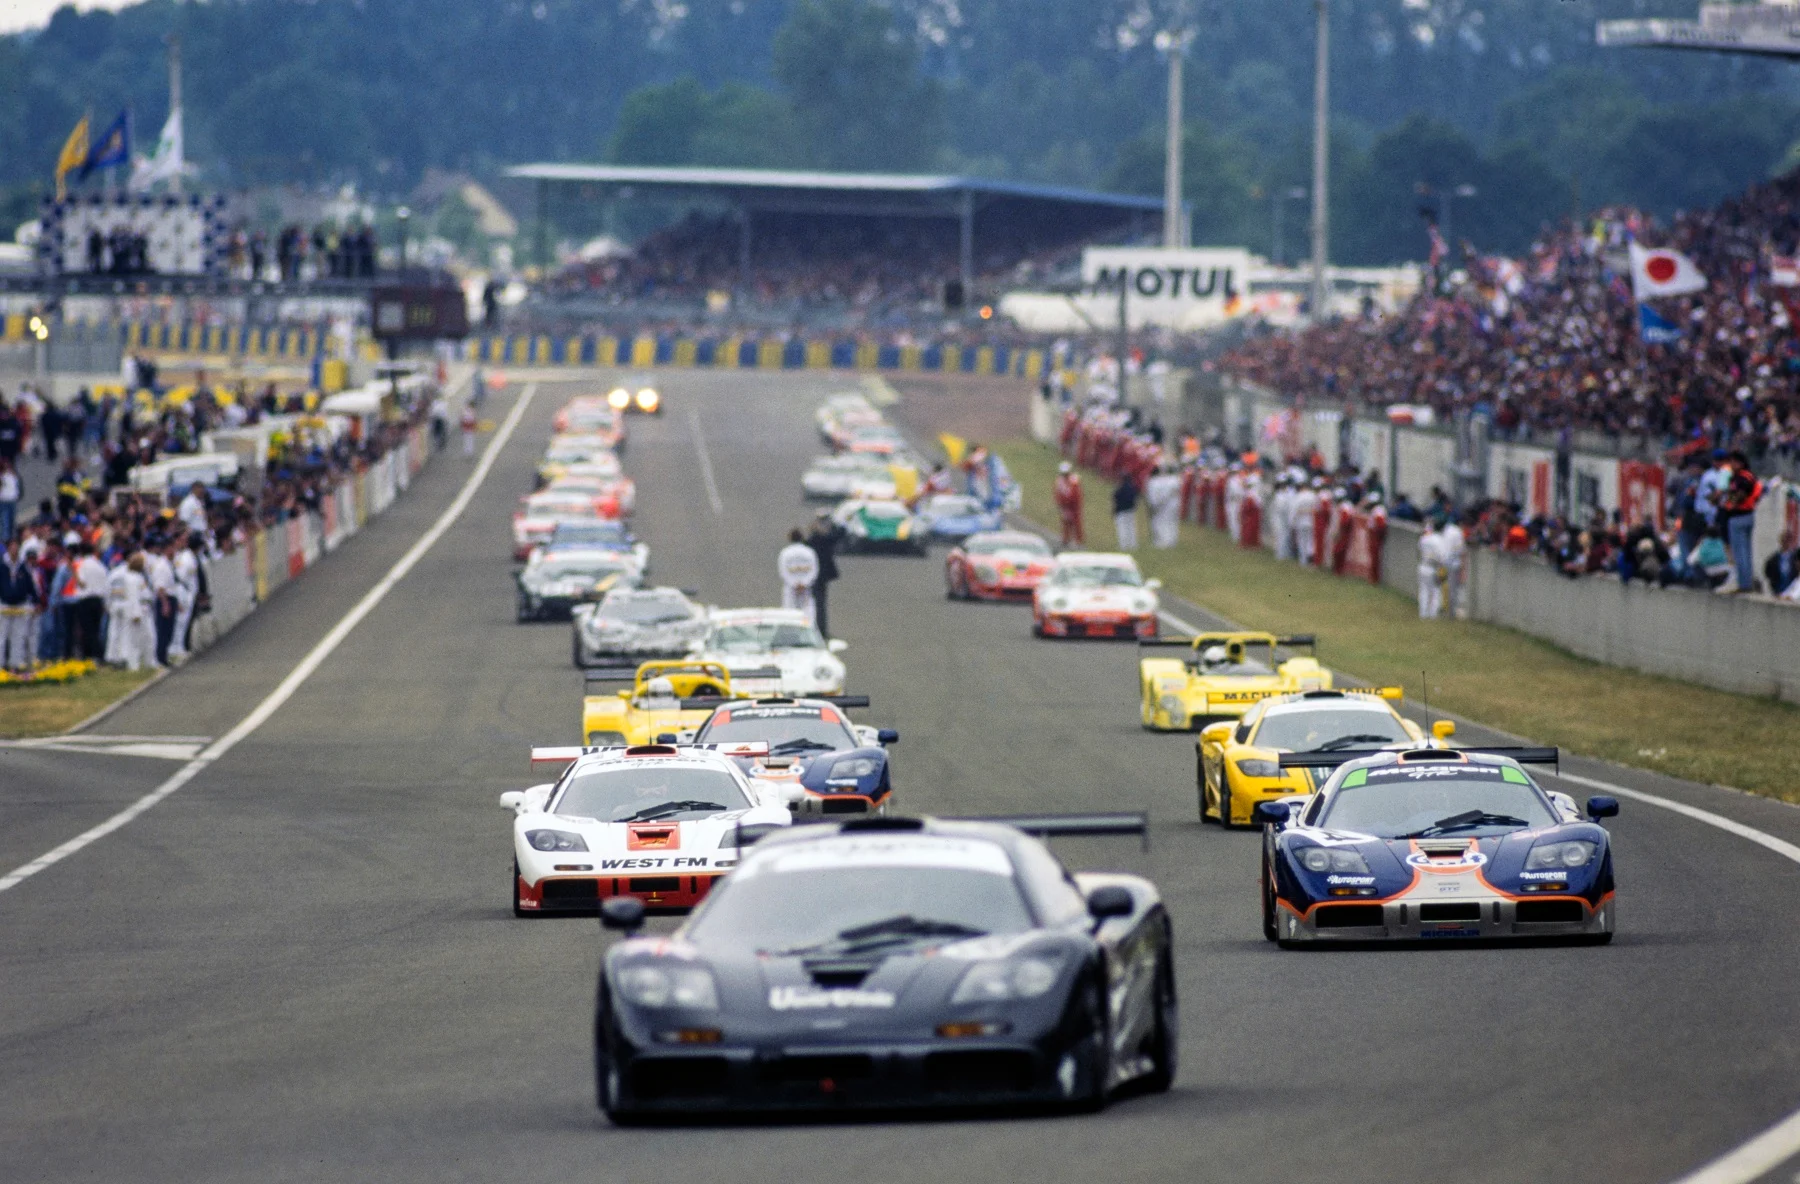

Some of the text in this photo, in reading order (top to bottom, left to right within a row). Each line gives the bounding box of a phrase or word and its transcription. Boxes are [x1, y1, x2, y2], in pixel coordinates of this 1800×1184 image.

[1093, 266, 1236, 299] MOTUL
[601, 856, 708, 870] WEST FM
[1420, 929, 1481, 937] MICHELIN
